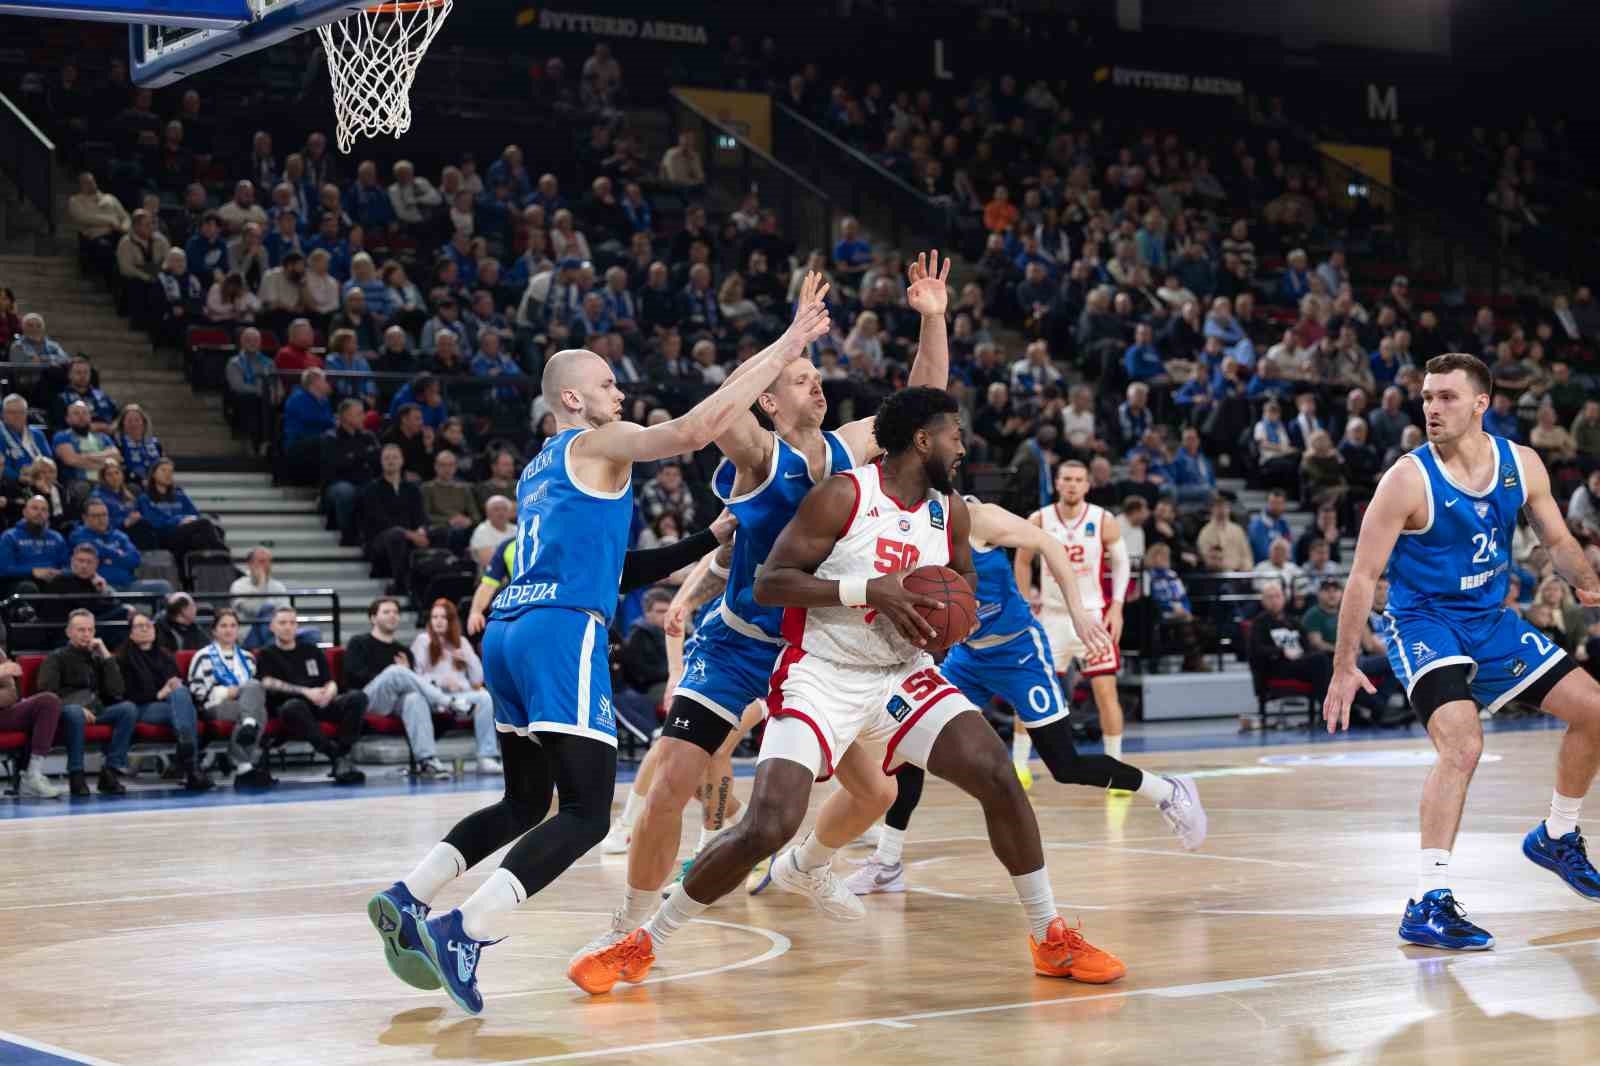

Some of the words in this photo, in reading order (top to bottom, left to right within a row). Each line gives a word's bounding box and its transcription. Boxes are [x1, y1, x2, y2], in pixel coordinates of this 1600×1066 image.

[640, 21, 708, 44] ARENA
[934, 39, 953, 79] L
[1368, 84, 1398, 120] M
[517, 514, 540, 576] 11
[874, 537, 920, 574] 50
[1064, 545, 1084, 562] 2
[492, 579, 558, 609] AIPĖDA
[1521, 632, 1553, 656] 2
[1028, 685, 1050, 713] 0
